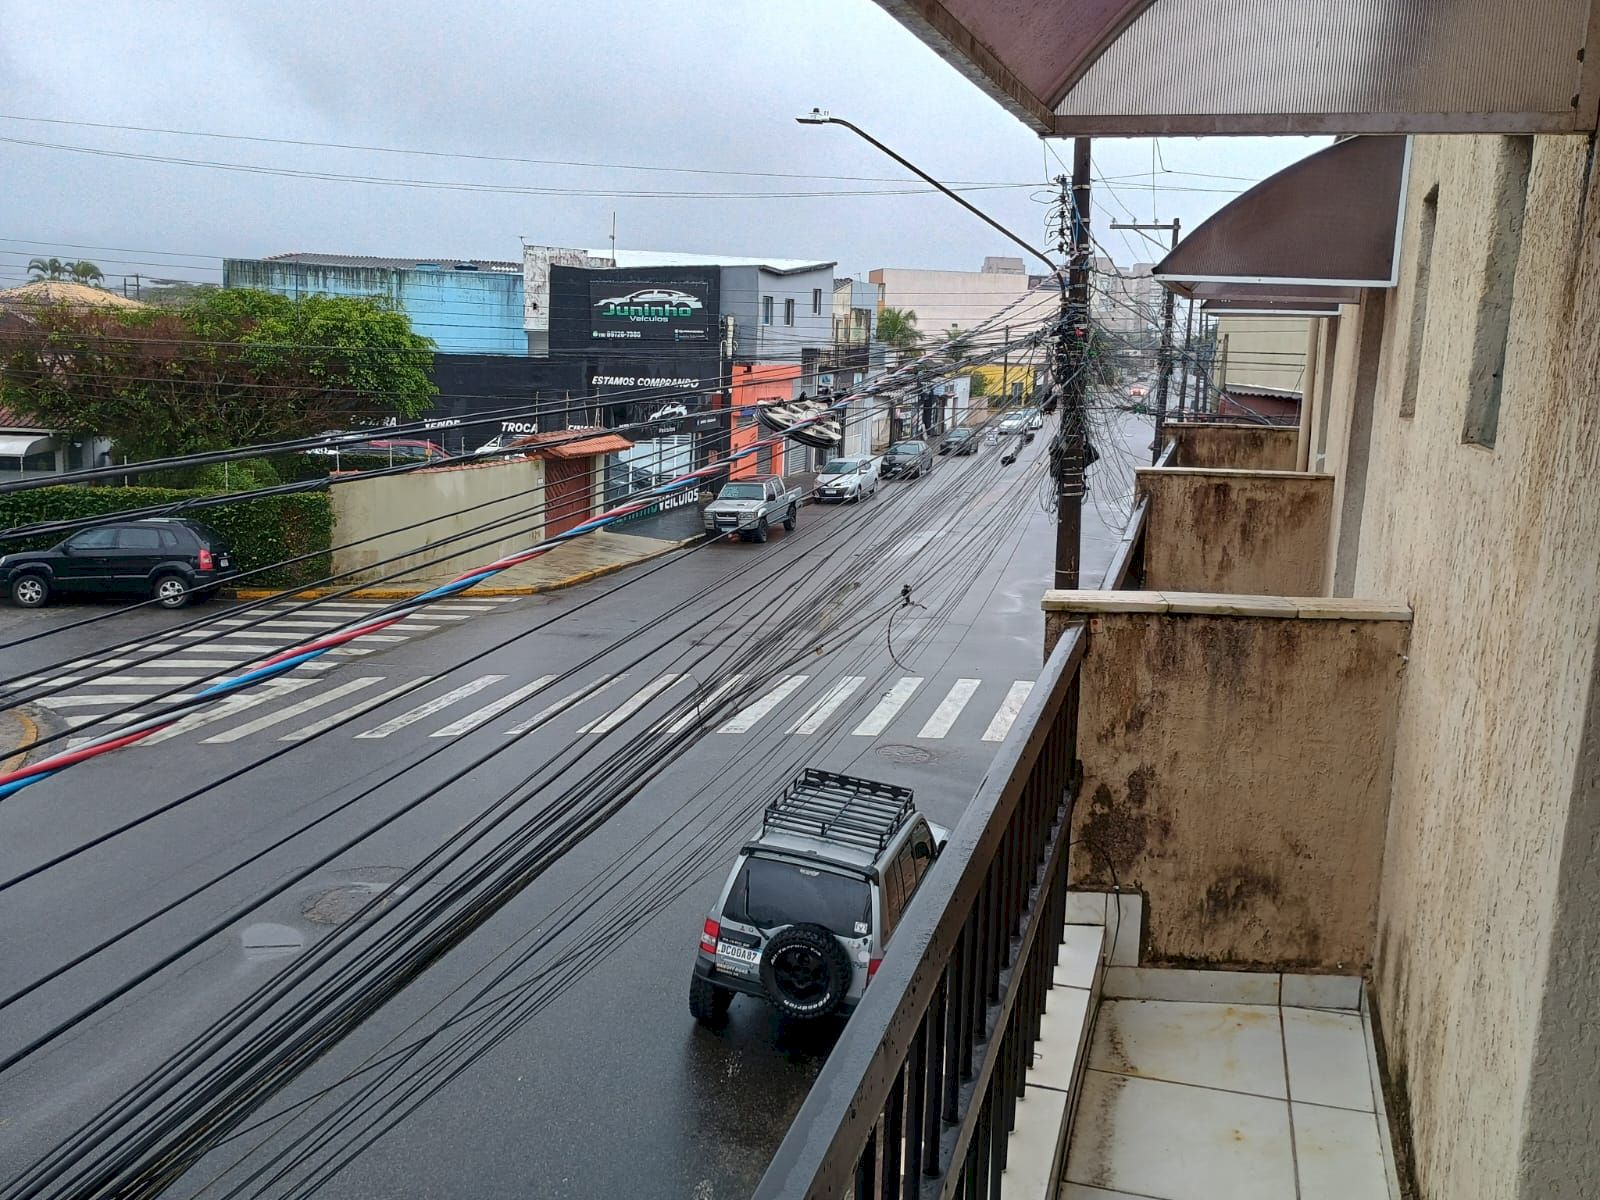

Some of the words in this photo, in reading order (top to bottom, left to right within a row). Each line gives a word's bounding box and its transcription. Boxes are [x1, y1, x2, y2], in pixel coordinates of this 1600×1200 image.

[602, 303, 692, 317] Juninho
[591, 375, 635, 387] ESTAMOS
[501, 421, 538, 434] TROCA
